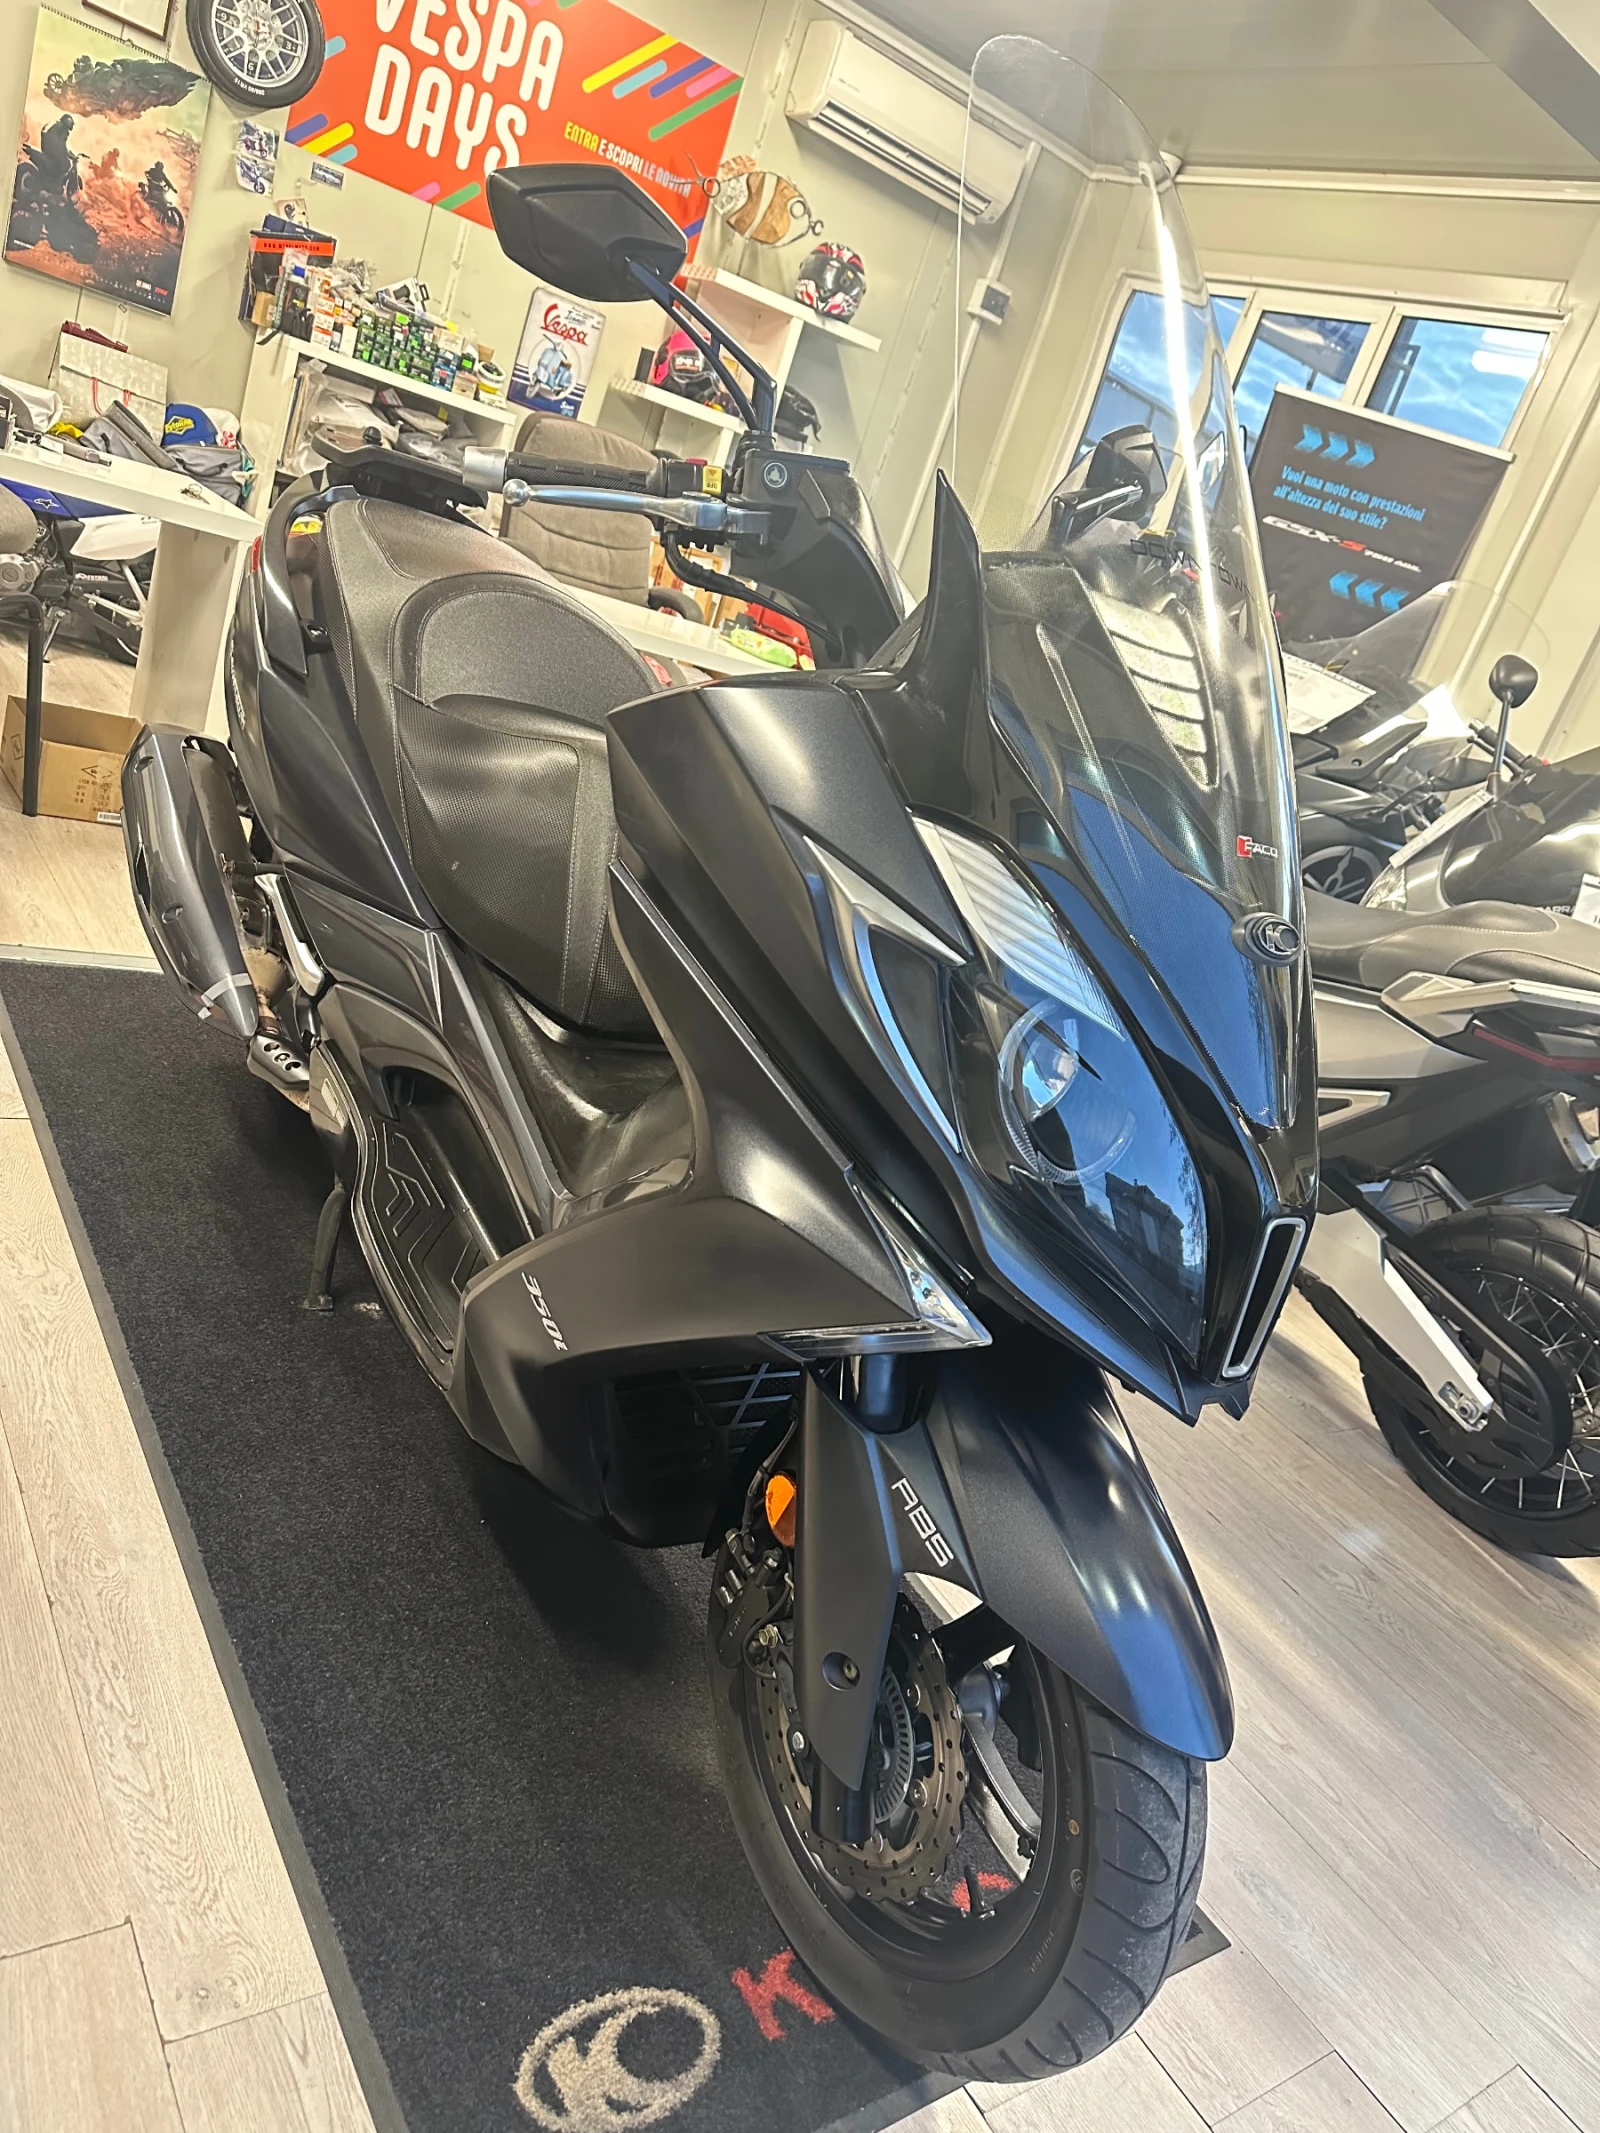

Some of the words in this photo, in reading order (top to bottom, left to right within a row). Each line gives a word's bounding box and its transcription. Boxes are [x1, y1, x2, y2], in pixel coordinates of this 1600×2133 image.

[365, 44, 528, 177] DAYS
[563, 121, 599, 152] ENTRA
[598, 138, 608, 157] E
[605, 143, 644, 174] SCOPRI
[642, 160, 658, 181] LE
[540, 303, 588, 346] Vespa
[1273, 485, 1322, 510] all'altezza
[1321, 499, 1341, 514] del
[1339, 506, 1358, 521] suo
[1359, 510, 1388, 530] stile?
[1281, 465, 1305, 484] Vuoi
[1304, 475, 1323, 490] una
[1323, 481, 1349, 499] moto
[1350, 490, 1369, 504] con
[1368, 495, 1426, 522] prestazioni
[1130, 538, 1255, 603] DOWNOWN
[891, 1477, 954, 1568] ABS
